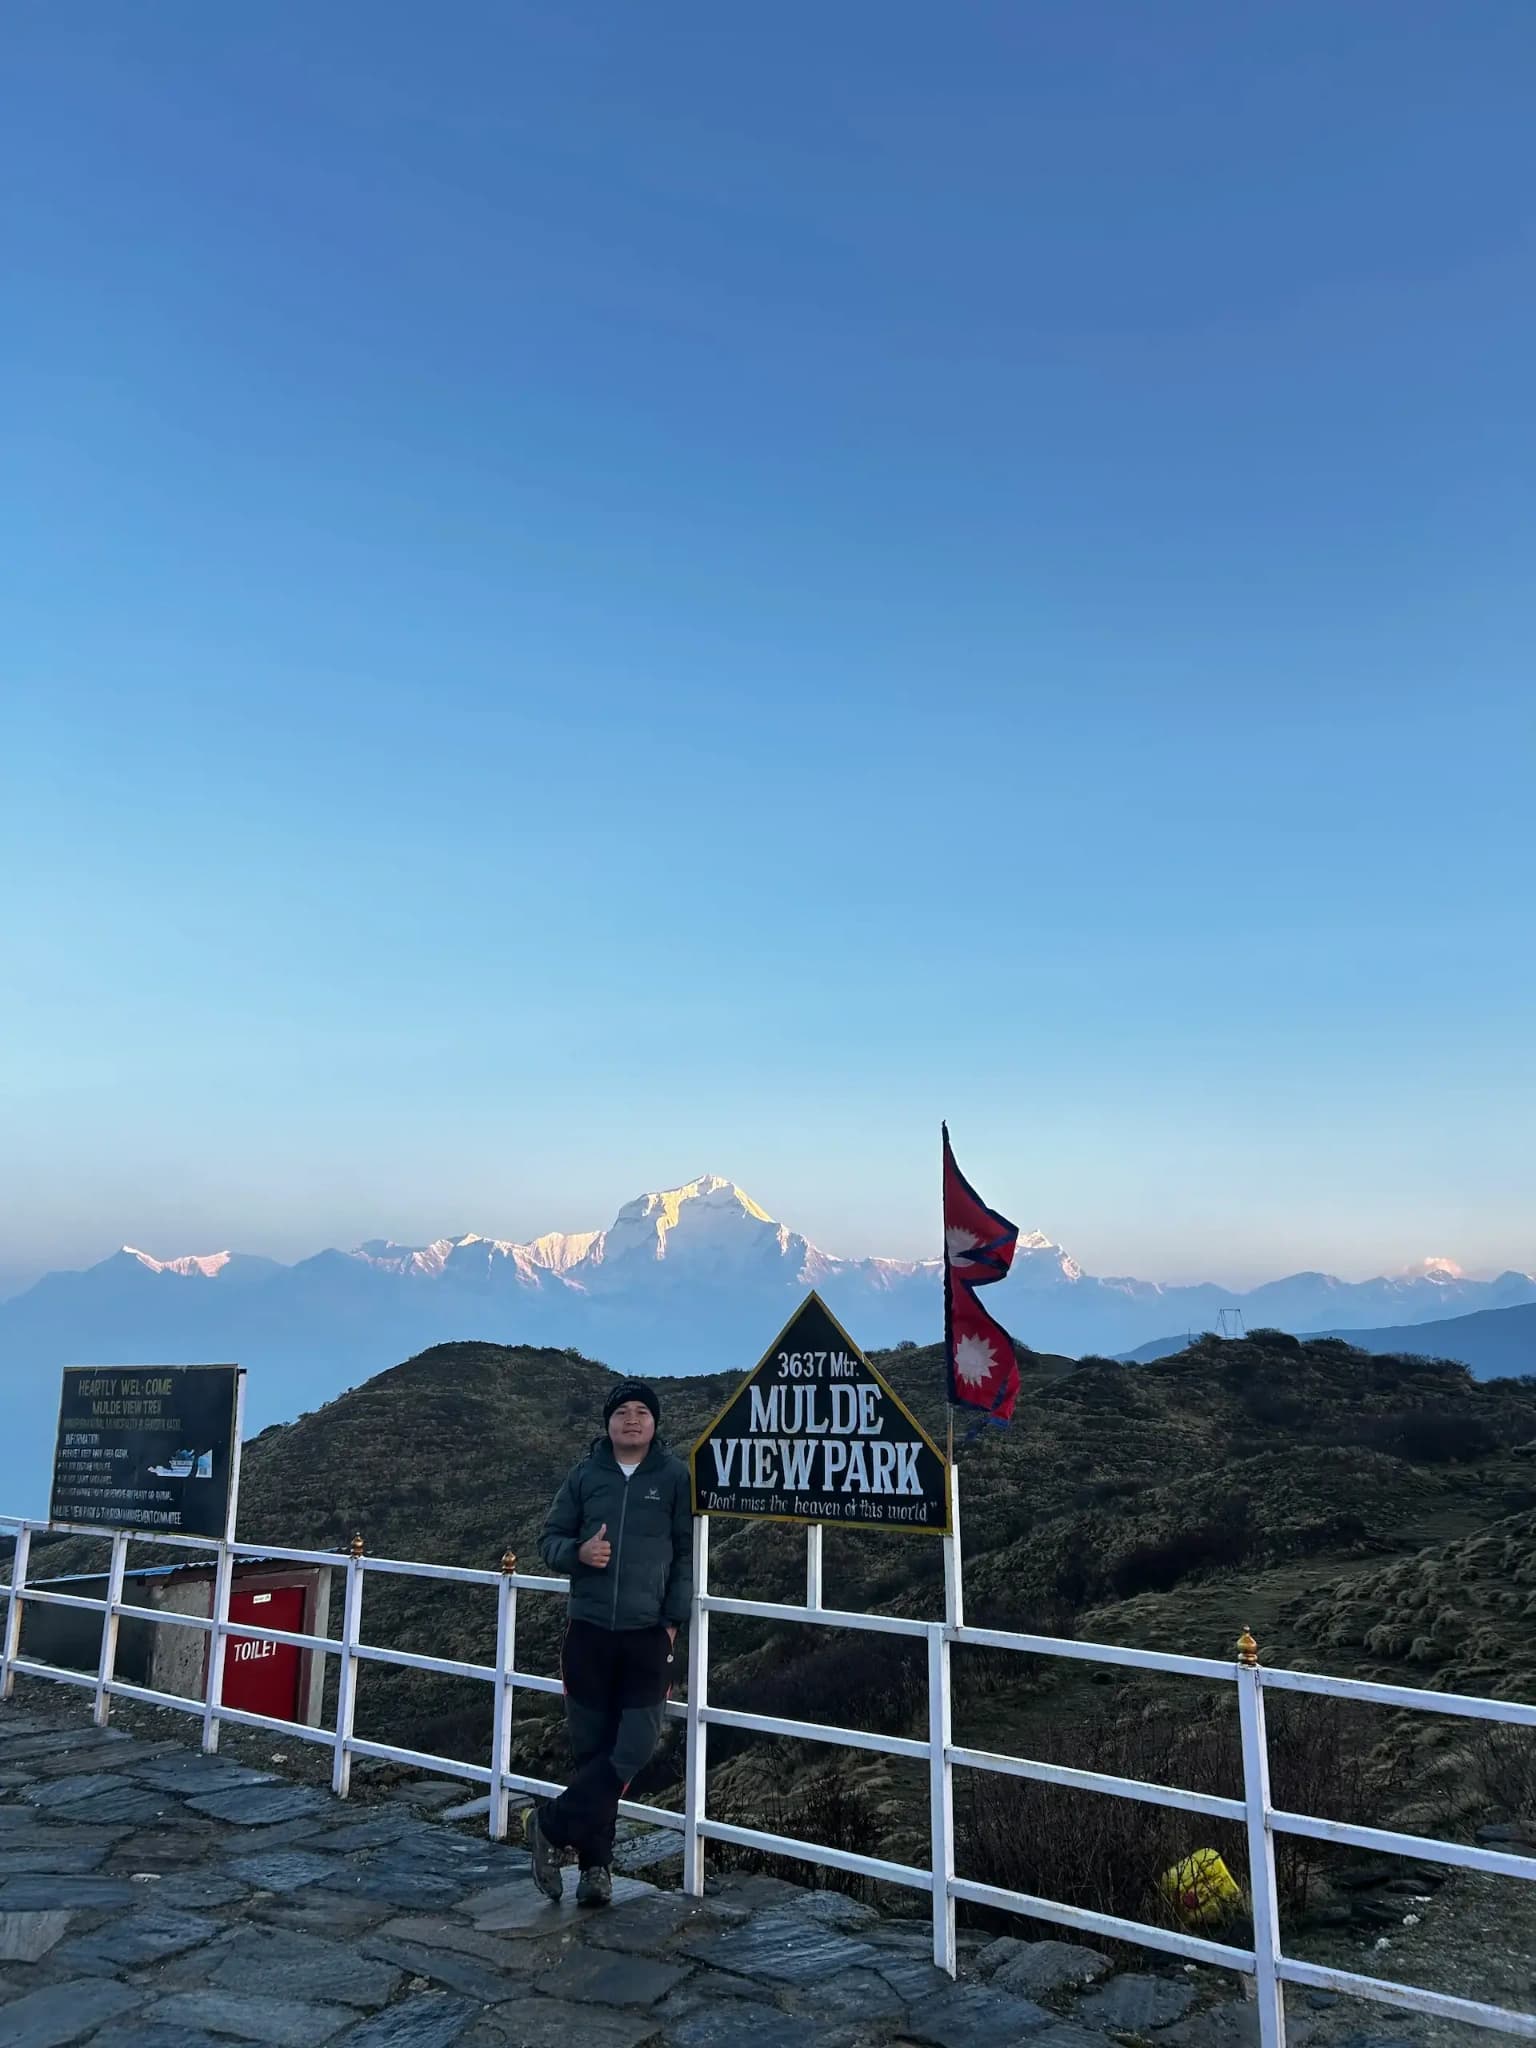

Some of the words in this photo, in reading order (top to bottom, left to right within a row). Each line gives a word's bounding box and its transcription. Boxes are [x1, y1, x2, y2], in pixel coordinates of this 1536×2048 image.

[778, 1352, 827, 1378] 3637
[830, 1351, 860, 1377] Mtr.
[78, 1379, 117, 1396] HEARTLY
[750, 1384, 884, 1435] MULDE
[709, 1438, 819, 1491] VIEW
[821, 1440, 924, 1496] PARK
[740, 1496, 766, 1512] miss
[769, 1494, 787, 1512] the
[794, 1492, 840, 1516] heaven
[844, 1500, 857, 1517] of
[859, 1499, 883, 1519] this
